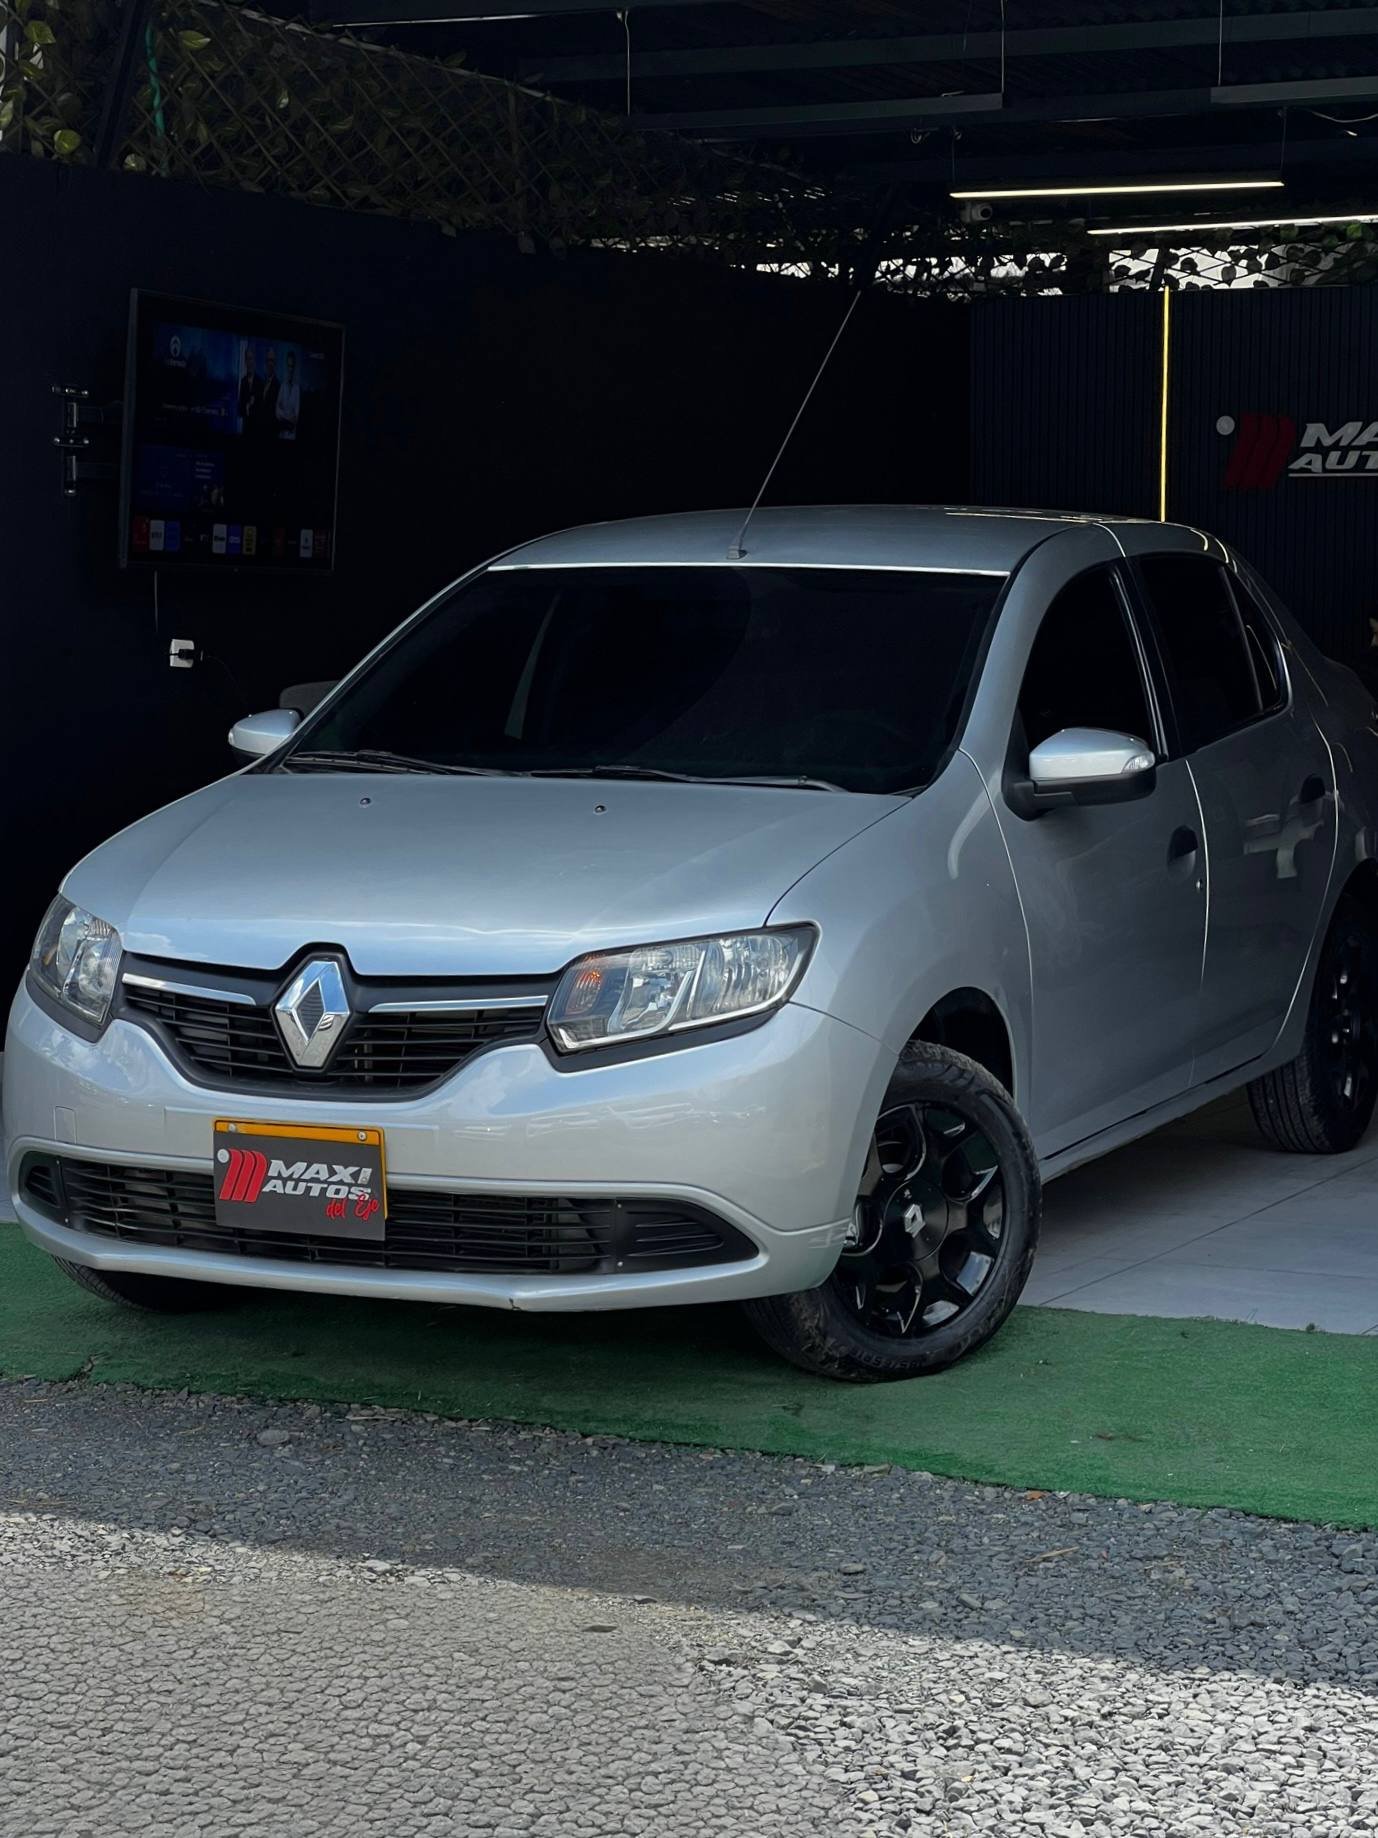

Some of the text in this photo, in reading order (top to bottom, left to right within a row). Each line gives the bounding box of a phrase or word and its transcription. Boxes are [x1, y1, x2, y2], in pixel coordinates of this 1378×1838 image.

[267, 1159, 373, 1185] MAXI
[262, 1179, 372, 1201] AUTOS
[325, 1193, 380, 1221] del Eje
